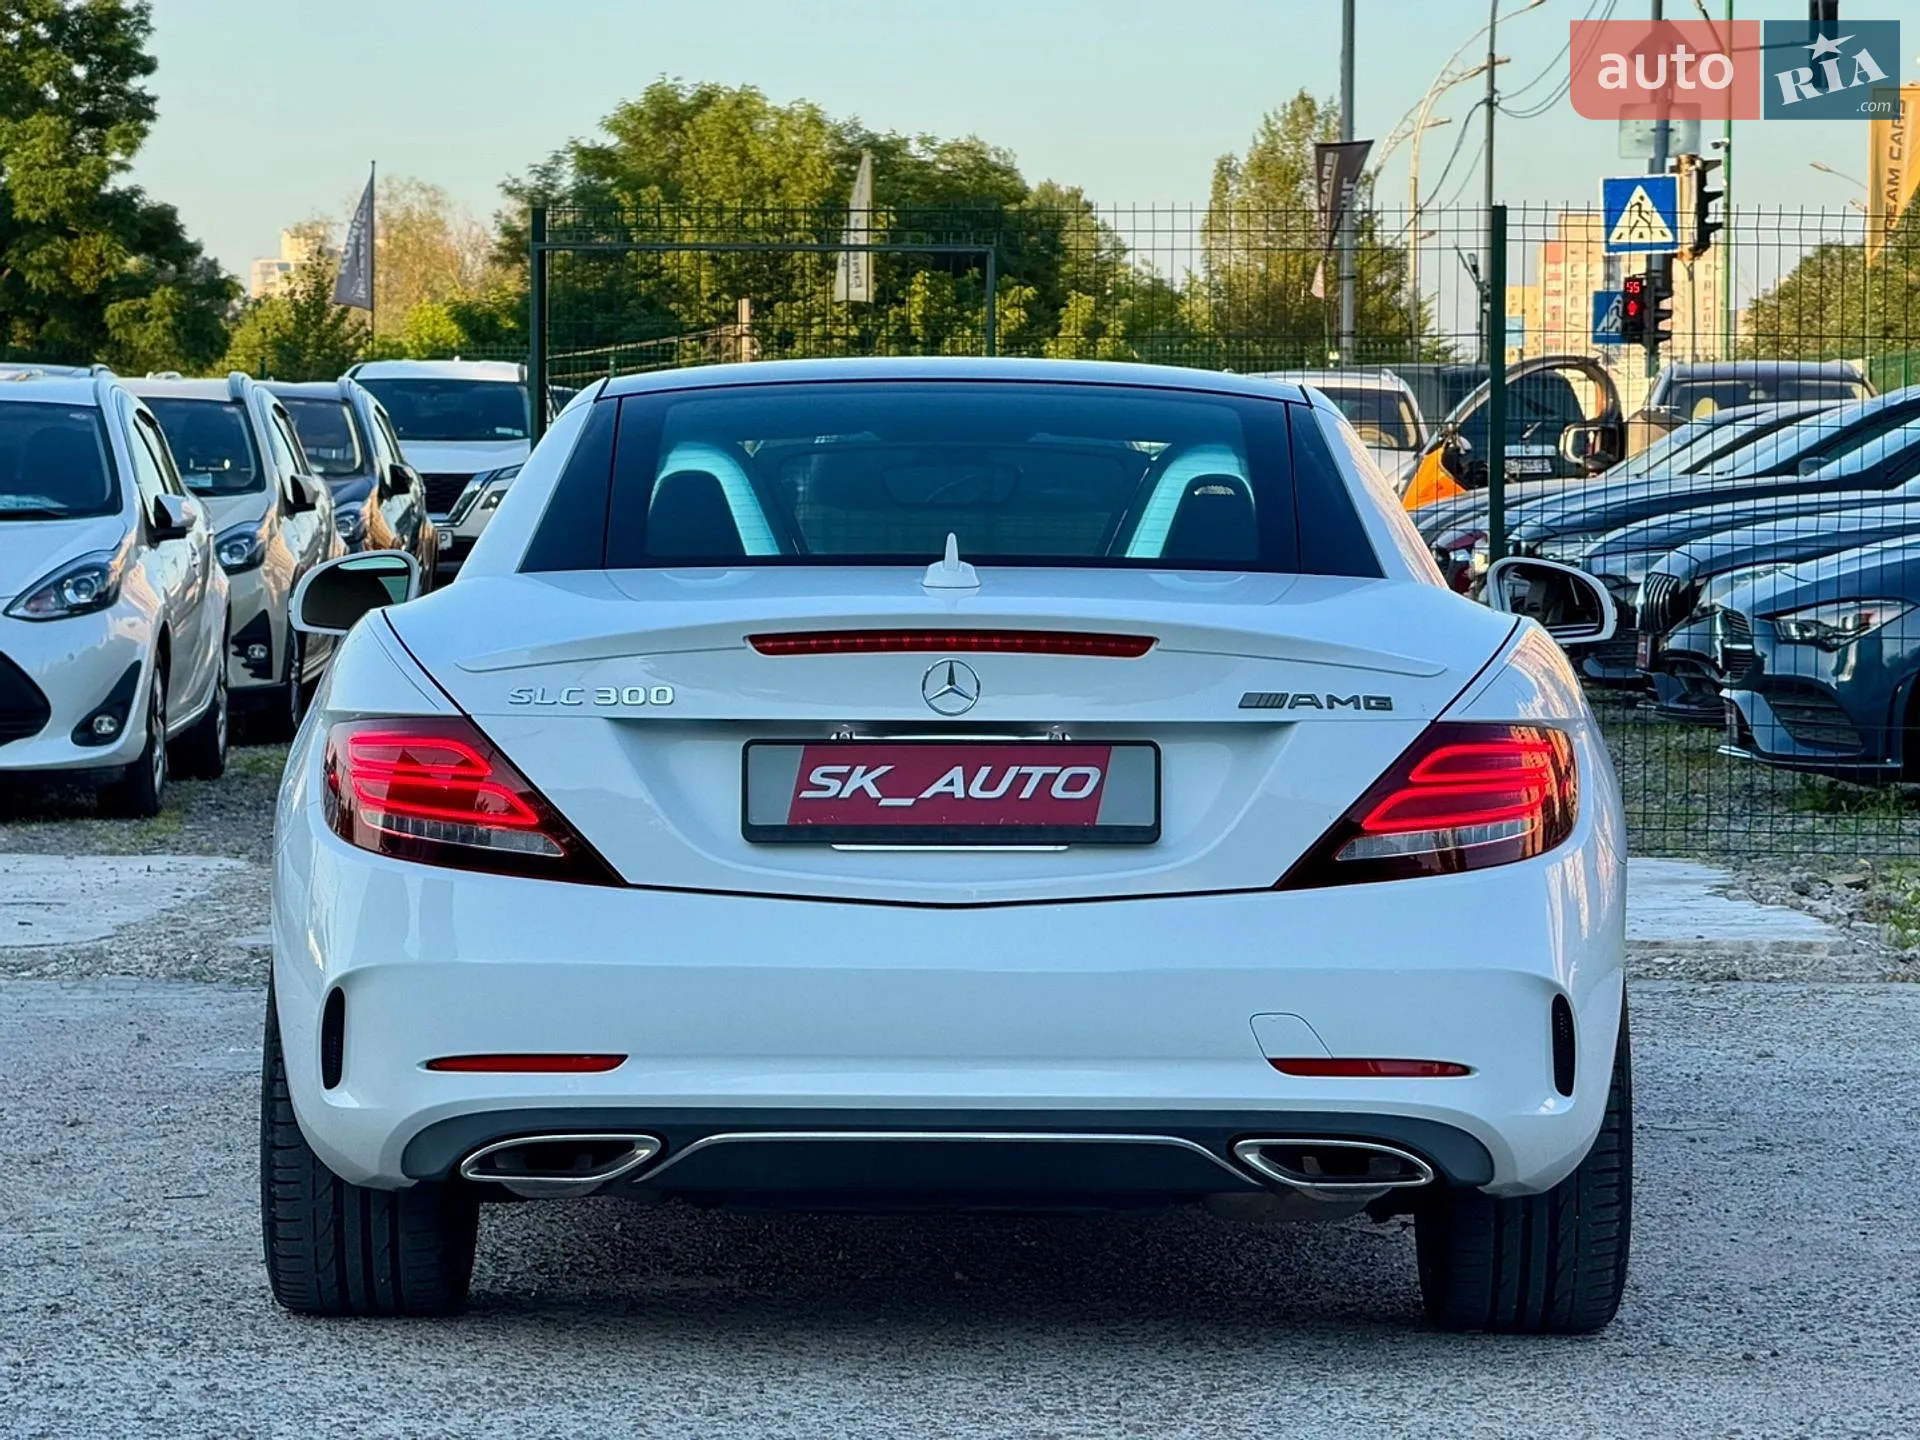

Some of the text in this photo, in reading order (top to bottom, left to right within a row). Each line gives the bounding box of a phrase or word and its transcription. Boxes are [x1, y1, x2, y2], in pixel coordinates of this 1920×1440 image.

[507, 686, 676, 707] SLC 300
[1287, 693, 1394, 711] AMG
[799, 764, 1103, 807] SK_AUTO
